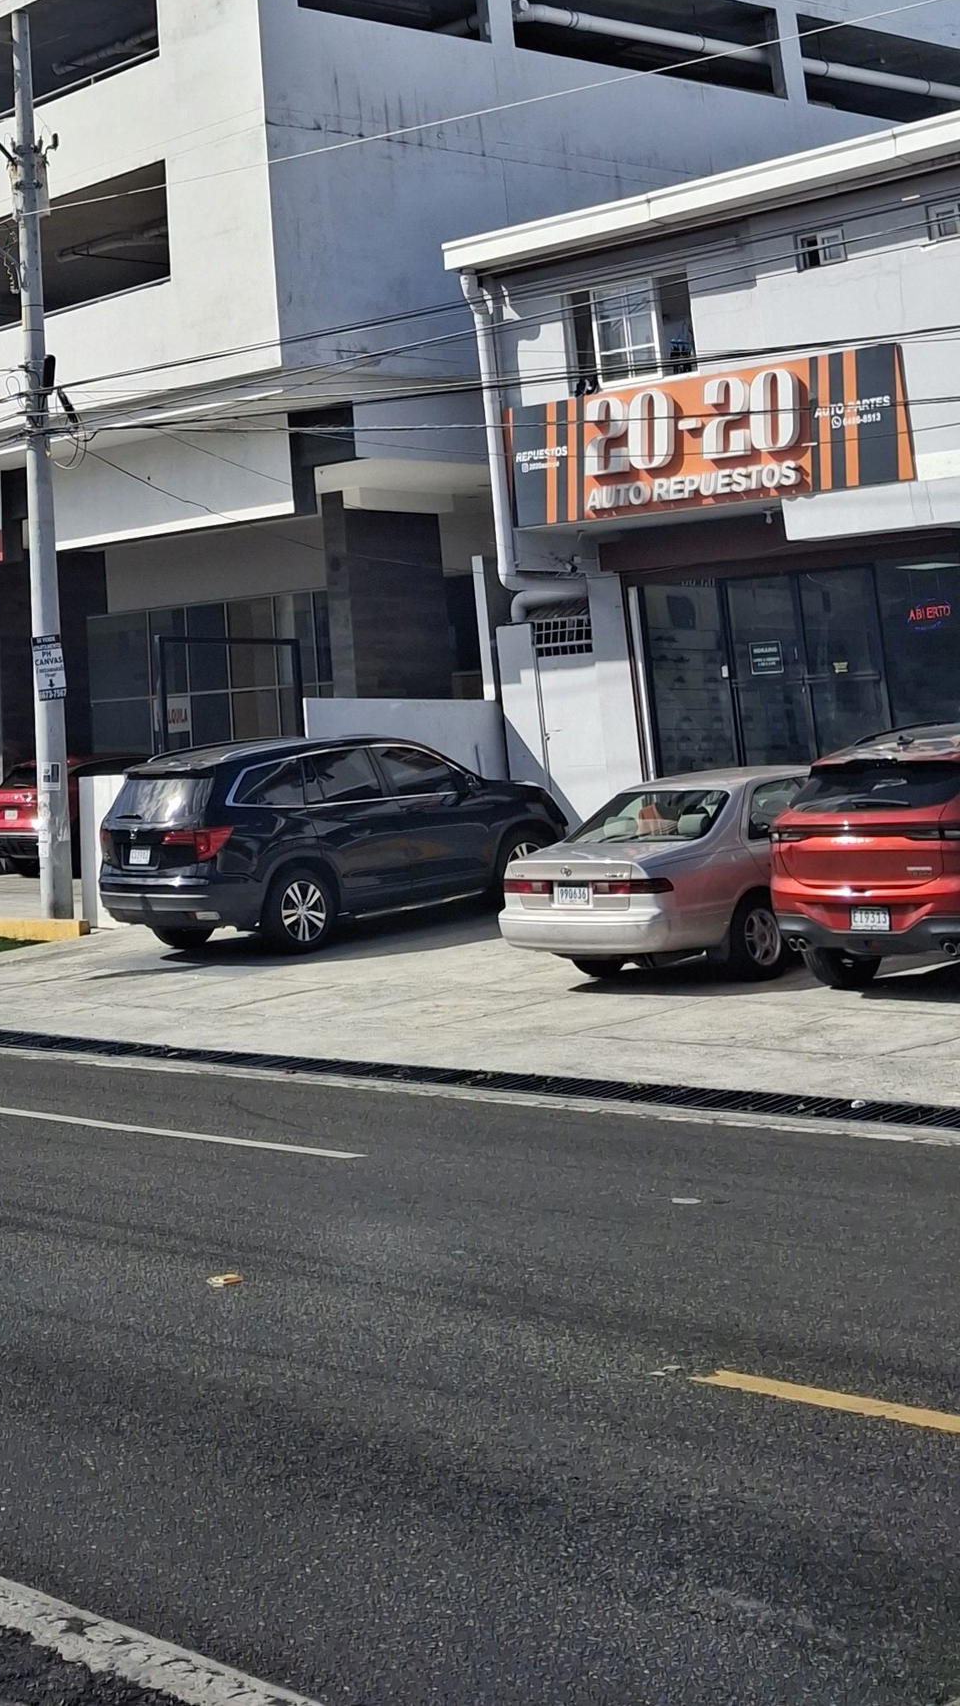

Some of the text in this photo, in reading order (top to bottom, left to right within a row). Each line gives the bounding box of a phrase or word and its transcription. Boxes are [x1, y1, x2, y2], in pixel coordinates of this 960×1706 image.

[814, 403, 845, 419] AUTO
[584, 368, 800, 476] 20-20
[516, 446, 568, 463] REPUESTOS
[587, 460, 801, 511] AUTO REPUESTOS
[907, 605, 951, 623] ABIERTO
[35, 656, 63, 667] CANVAS
